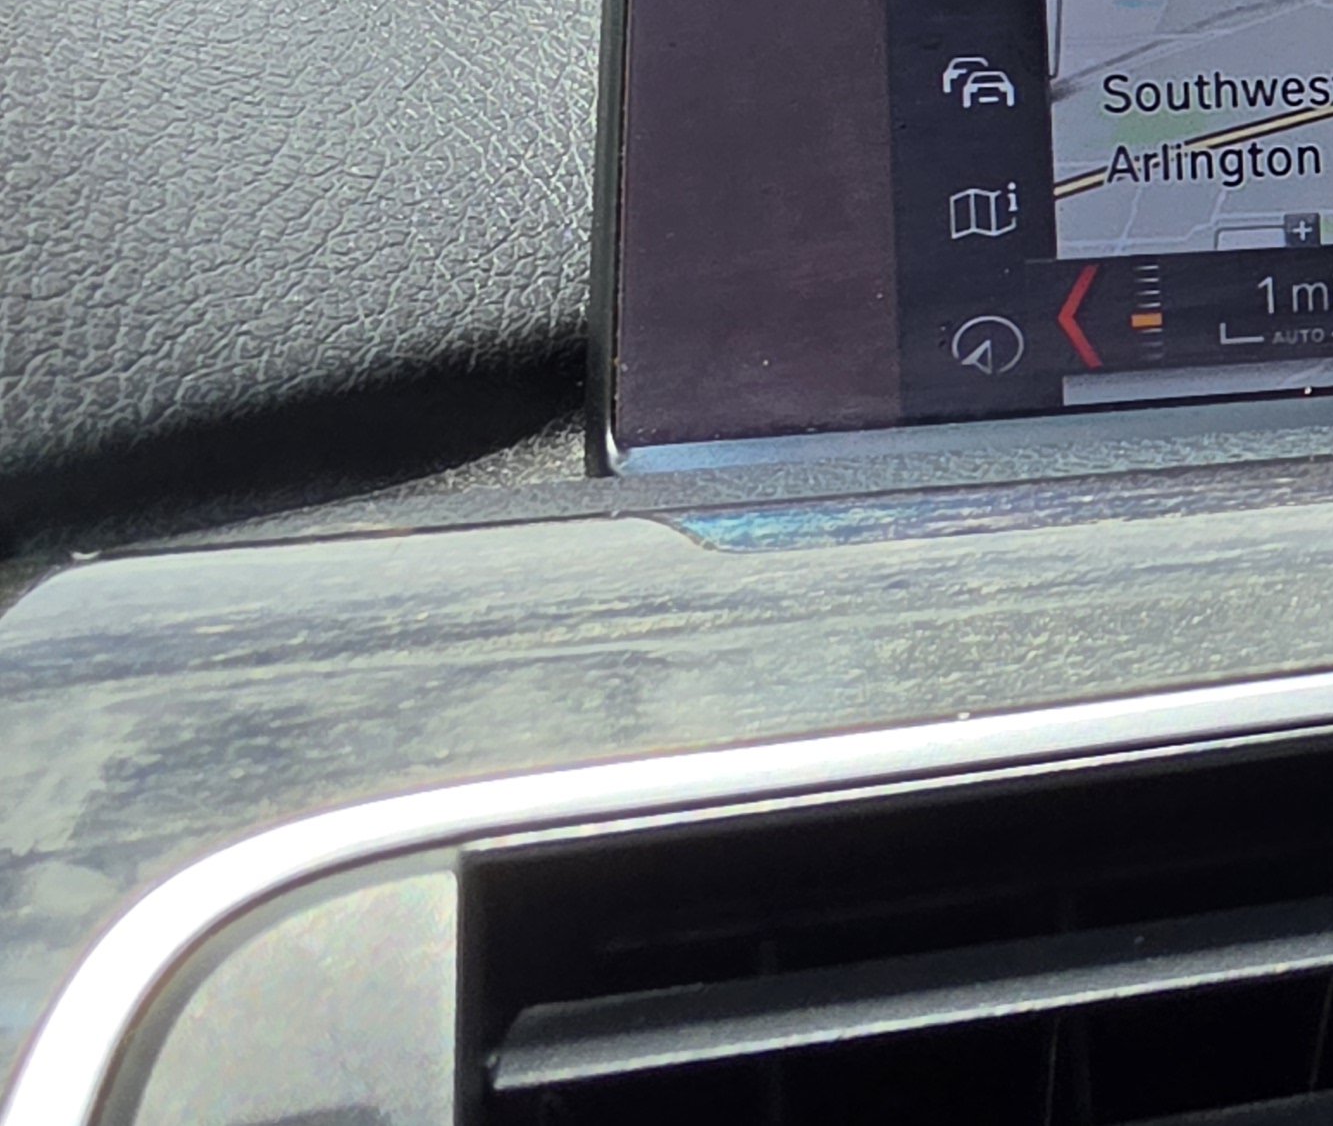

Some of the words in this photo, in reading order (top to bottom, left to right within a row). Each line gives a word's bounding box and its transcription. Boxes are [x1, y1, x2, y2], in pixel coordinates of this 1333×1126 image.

[1107, 143, 1323, 187] Arlington
[1257, 276, 1275, 314] 1
[1271, 327, 1326, 345] AUTO
